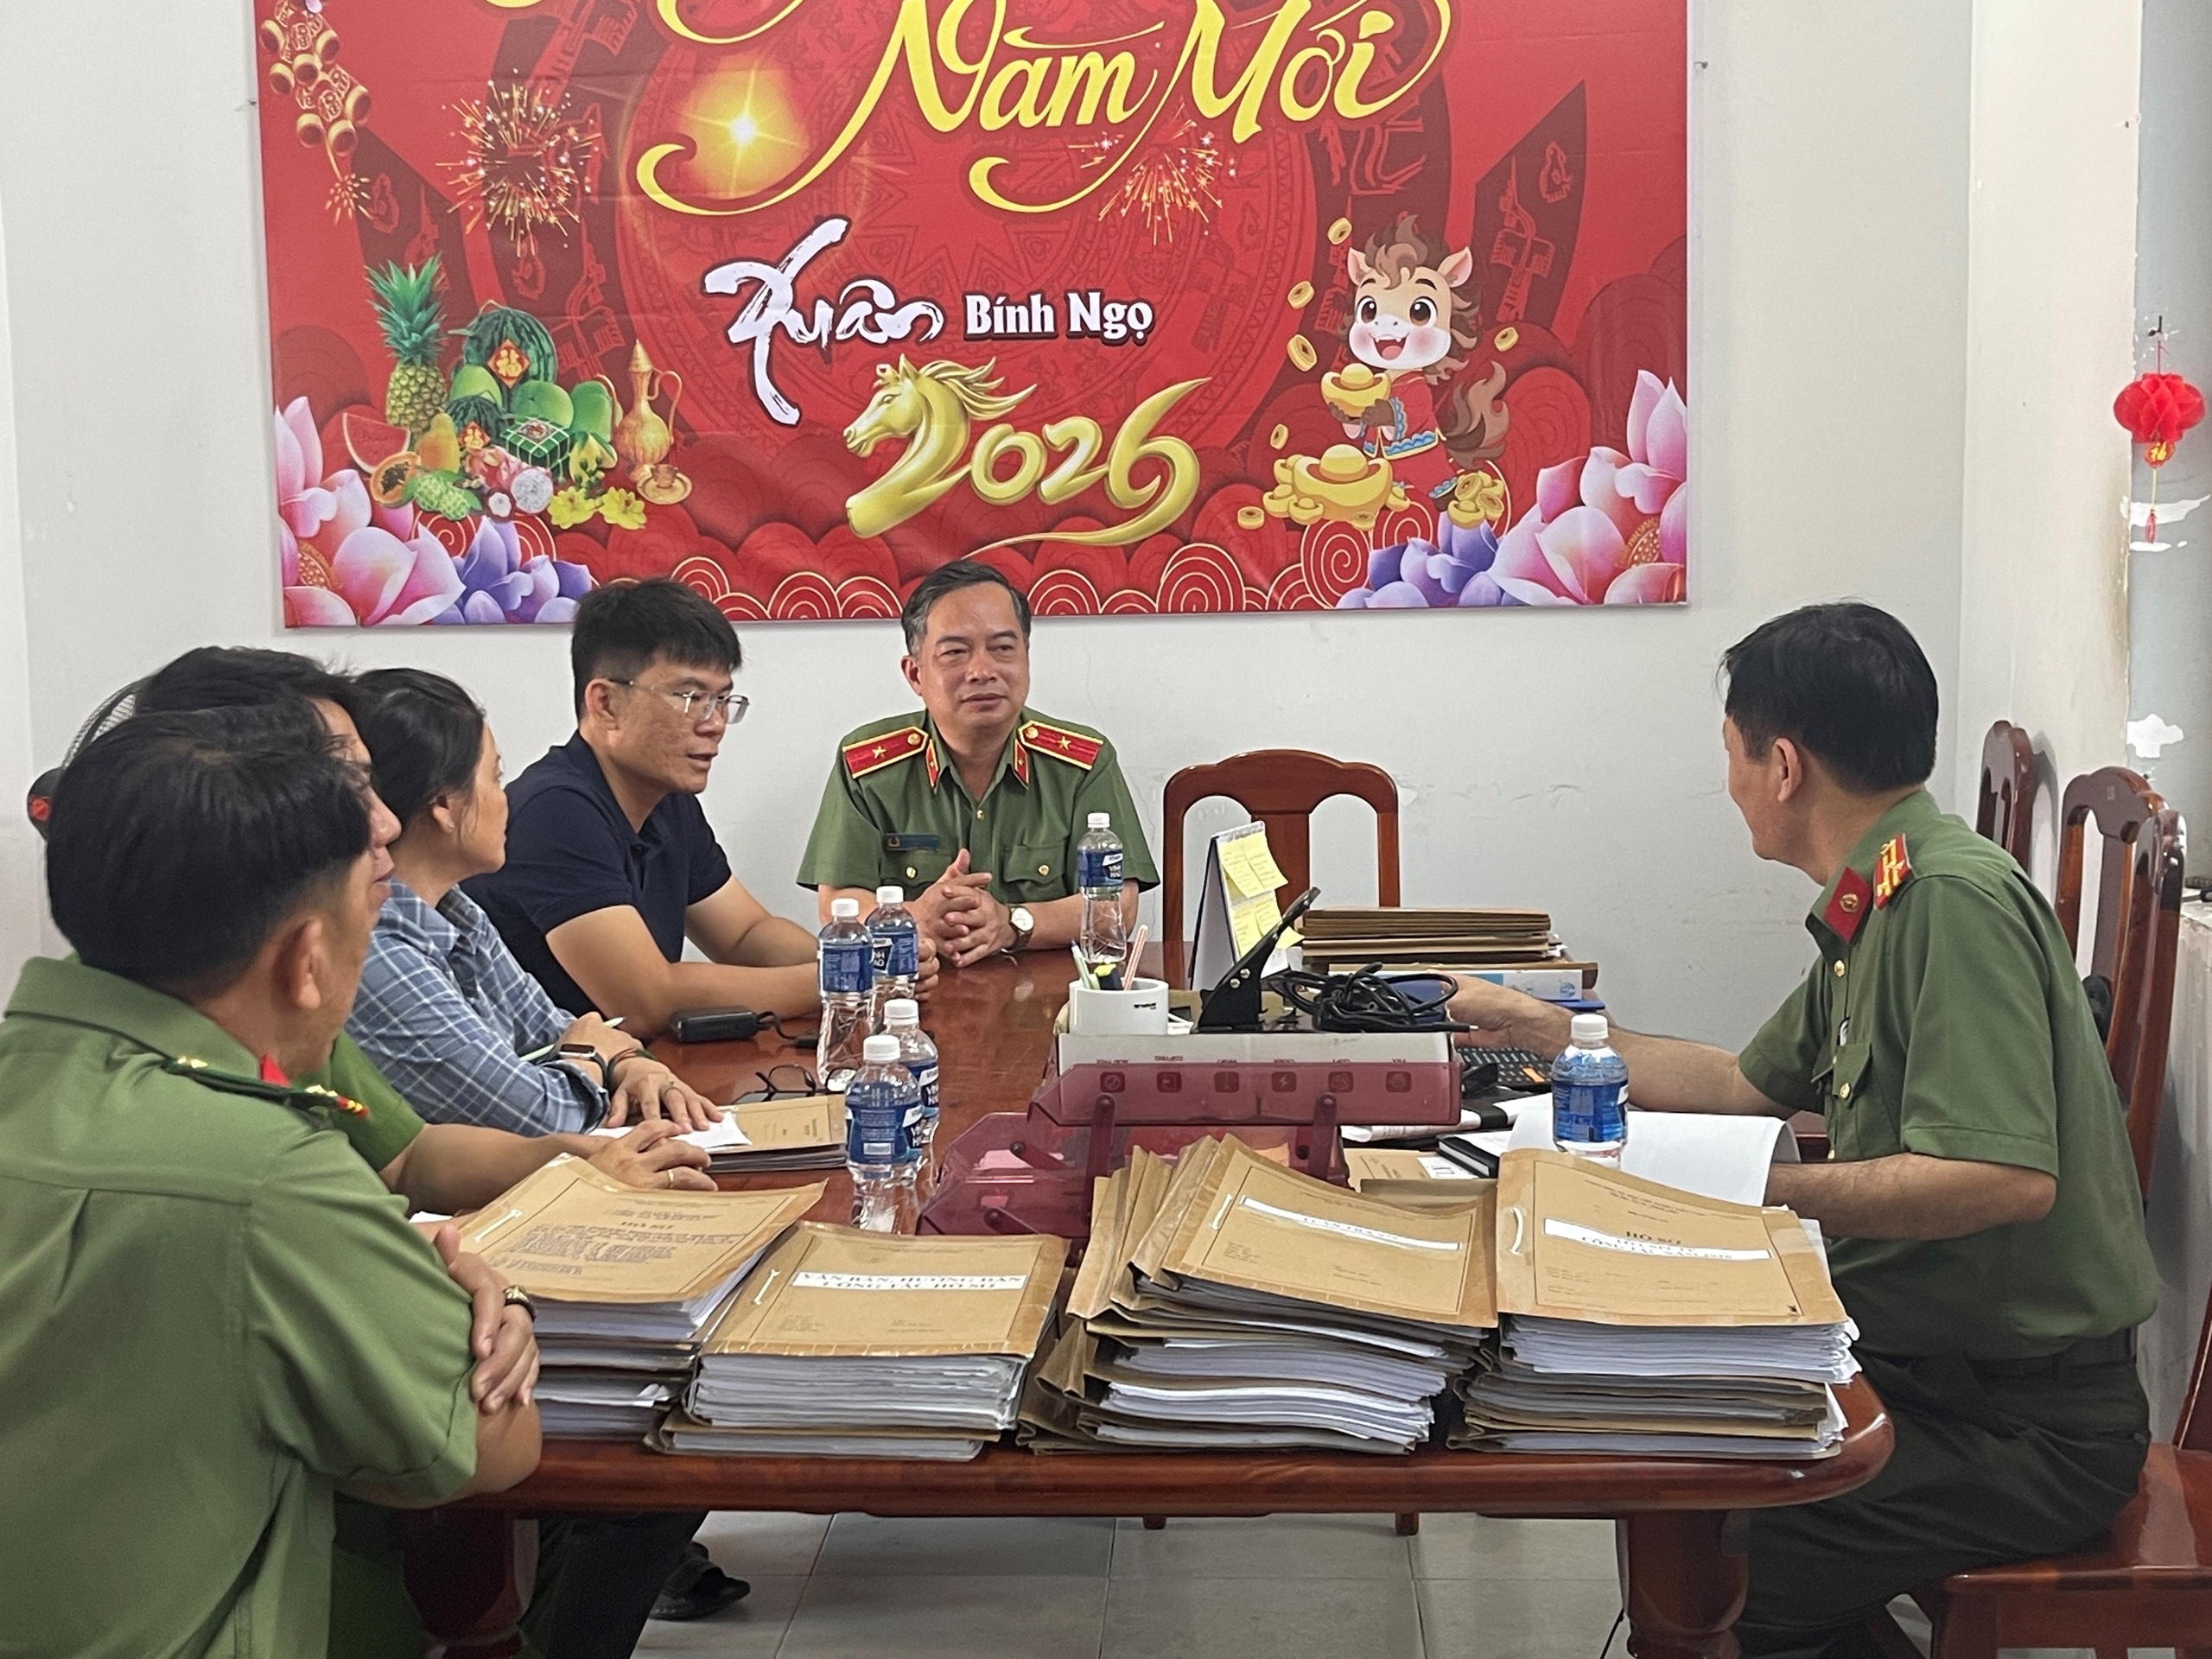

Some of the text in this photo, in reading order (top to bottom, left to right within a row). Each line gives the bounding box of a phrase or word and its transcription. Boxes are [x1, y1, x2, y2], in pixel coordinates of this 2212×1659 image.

[704, 218, 1154, 424] Xuân Bính Ngọ
[843, 353, 1212, 555] 2026
